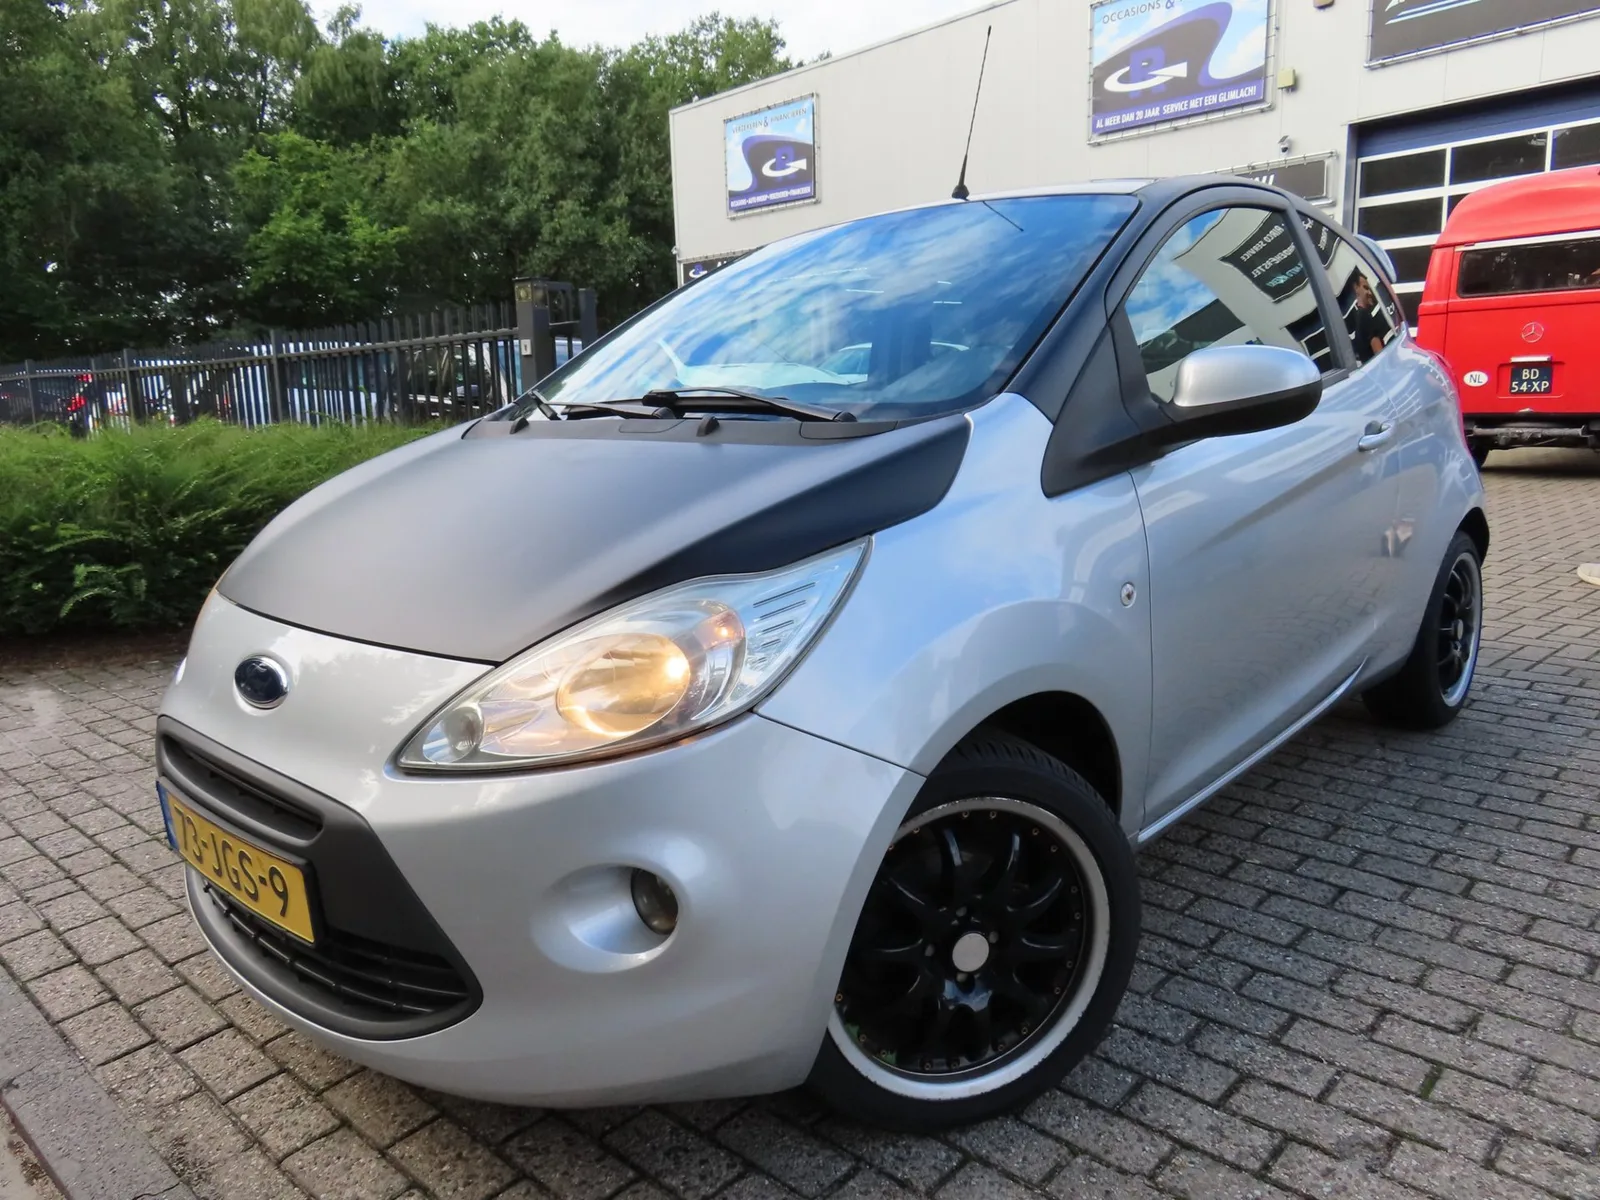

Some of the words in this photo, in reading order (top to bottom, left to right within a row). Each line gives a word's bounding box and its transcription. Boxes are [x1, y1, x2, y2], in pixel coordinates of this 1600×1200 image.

[1102, 0, 1161, 24] OCCASIONS
[1096, 118, 1104, 128] AL
[1105, 116, 1121, 126] MEER
[1121, 114, 1135, 123] DAN
[1135, 111, 1144, 120] 20
[1144, 107, 1160, 119] JAAR
[1162, 101, 1189, 115] SERVICE
[1189, 97, 1203, 109] MET
[1204, 94, 1218, 106] EEN
[1218, 85, 1257, 103] GLIMLACH!
[1469, 373, 1483, 384] NL
[1522, 368, 1540, 380] BD
[1510, 380, 1550, 393] 54-XP
[173, 803, 289, 918] 73-JGS-9
